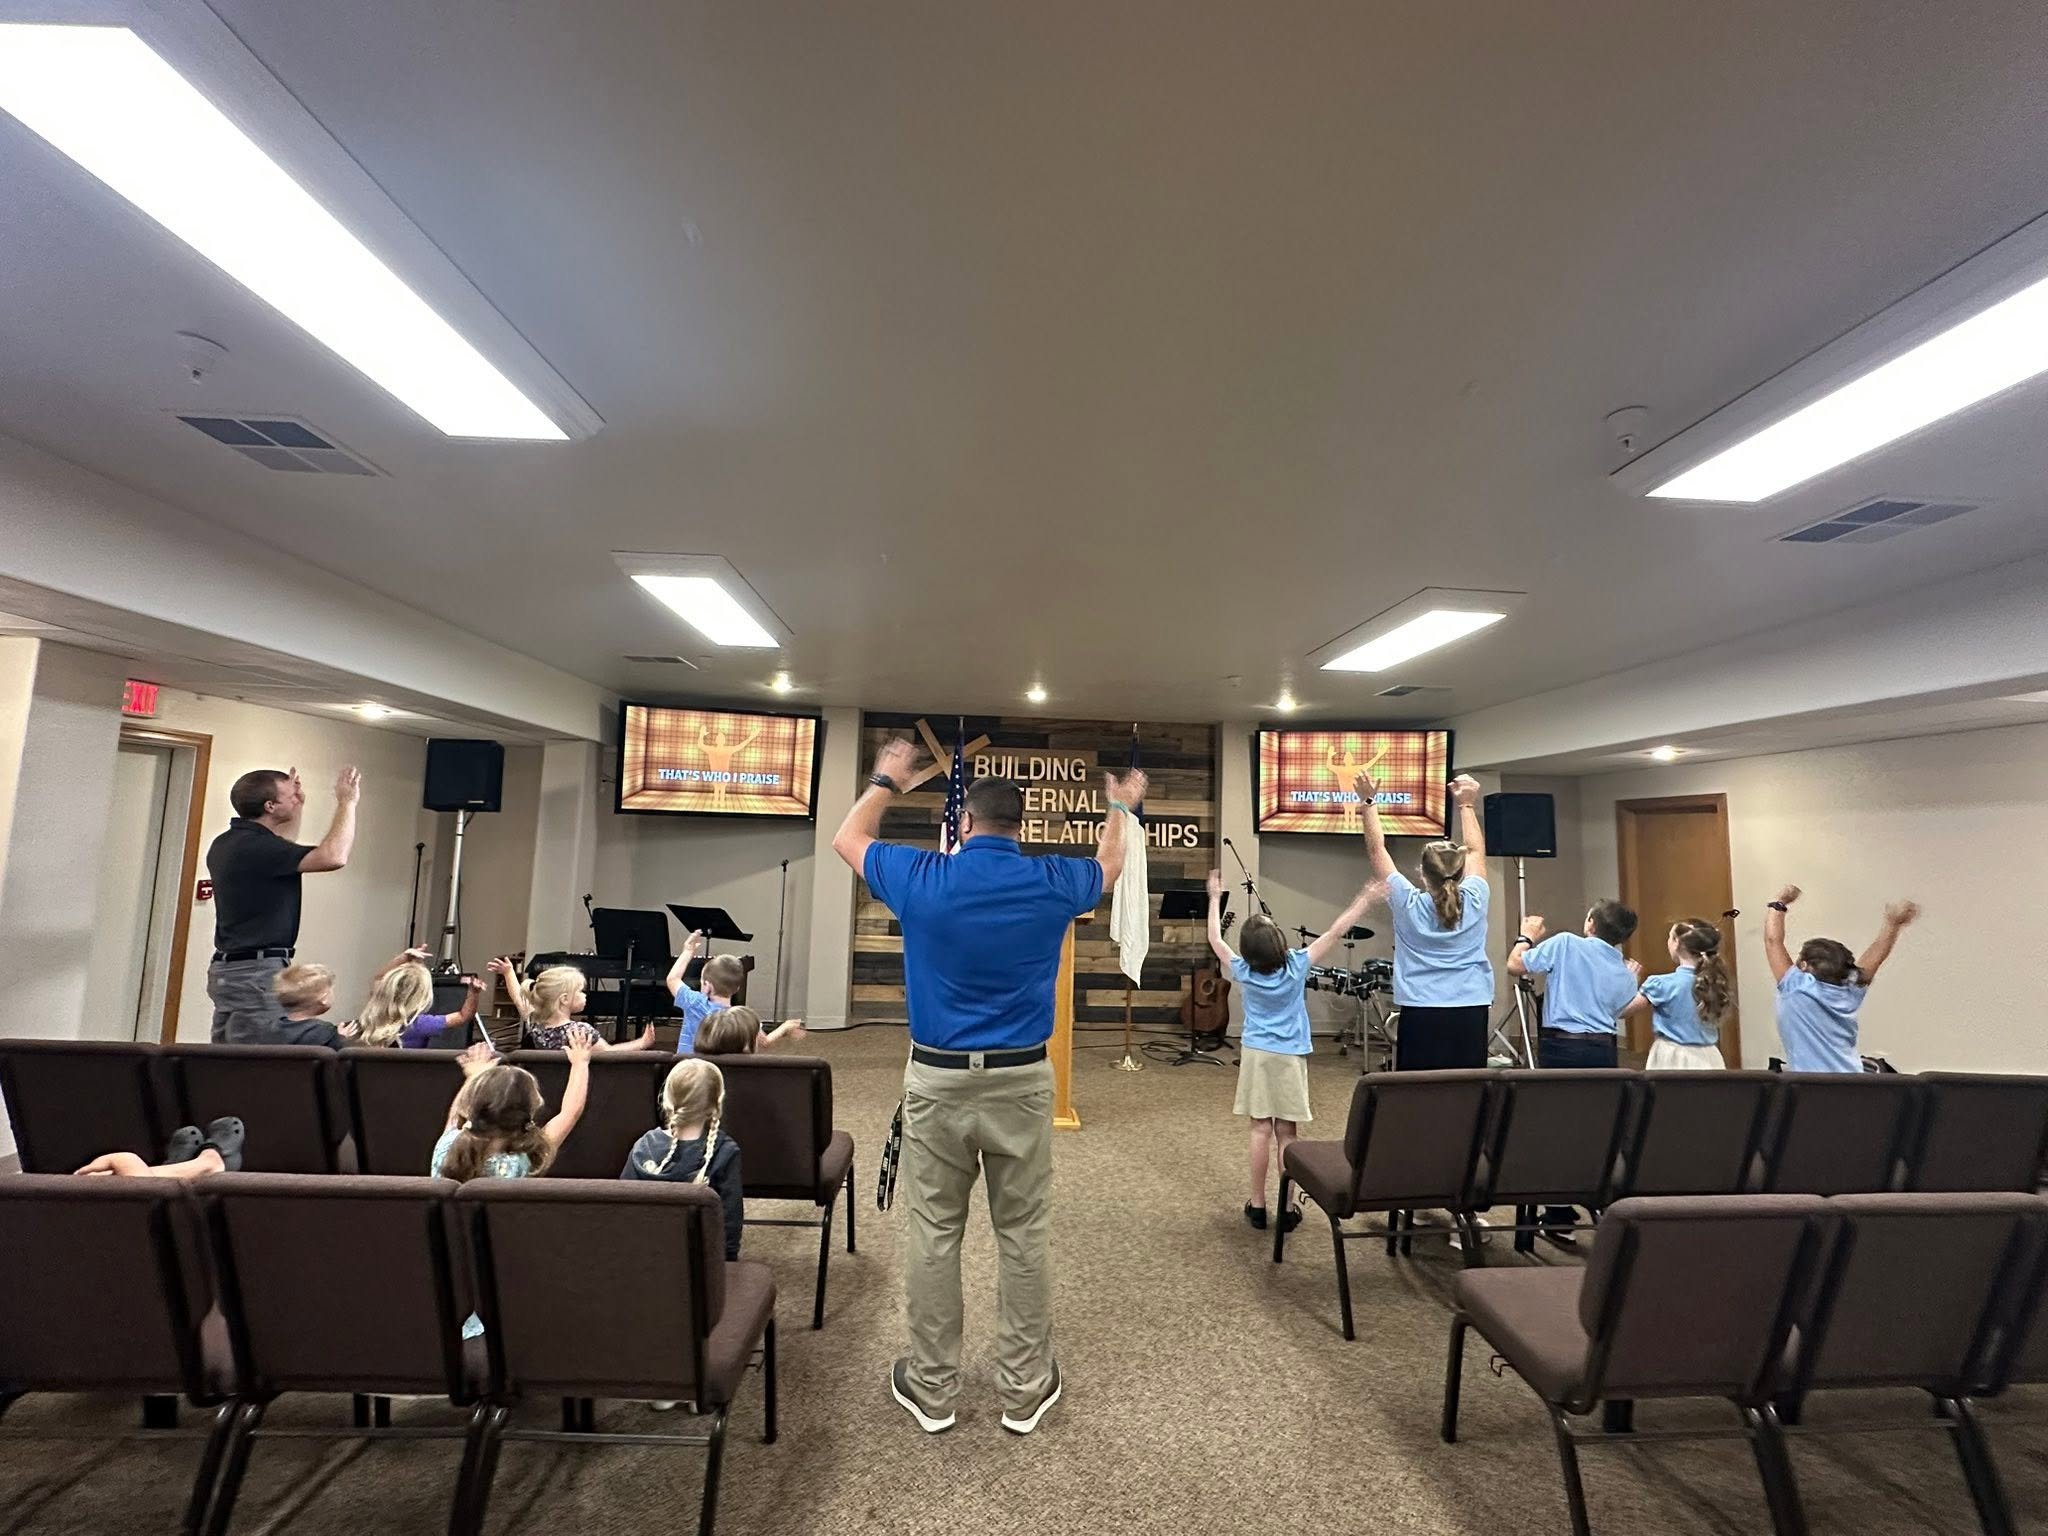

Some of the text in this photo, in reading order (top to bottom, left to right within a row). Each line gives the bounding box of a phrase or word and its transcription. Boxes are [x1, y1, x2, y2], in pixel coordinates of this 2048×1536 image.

[658, 768, 780, 785] THAT'S WHO I PRAISE
[974, 754, 1086, 782] BUILDING
[1019, 787, 1106, 813] ERNAL
[1291, 790, 1330, 802] THAT'S
[1375, 792, 1412, 804] RAISE
